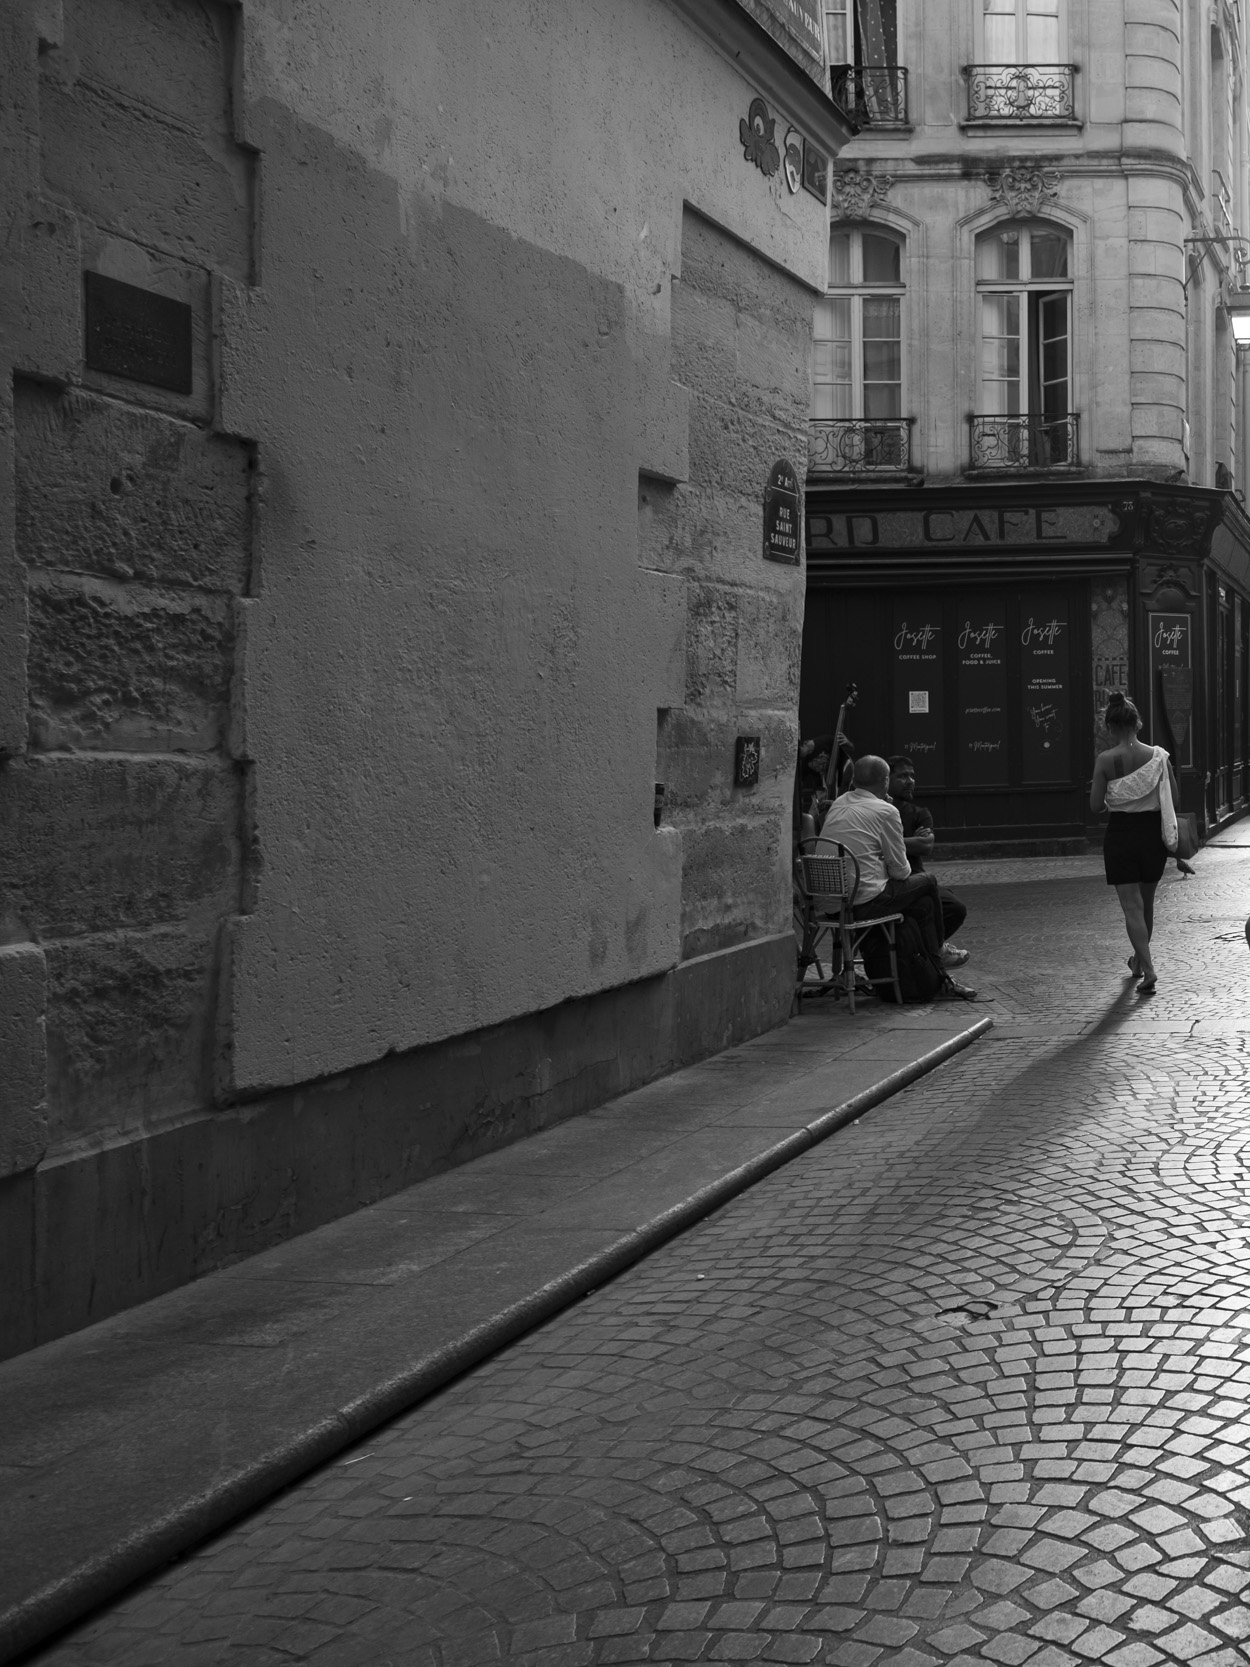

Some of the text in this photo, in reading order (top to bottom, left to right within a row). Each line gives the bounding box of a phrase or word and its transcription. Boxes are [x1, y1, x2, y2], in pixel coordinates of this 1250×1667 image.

[779, 506, 791, 520] RUE
[923, 508, 1067, 542] CAFE
[776, 520, 793, 534] SAINT
[770, 533, 796, 549] SAUVEUR
[894, 621, 941, 650] Josette
[958, 620, 1005, 649] Josette
[1022, 617, 1068, 646] Josette
[1154, 621, 1187, 648] Josette
[1095, 664, 1127, 687] CAFE
